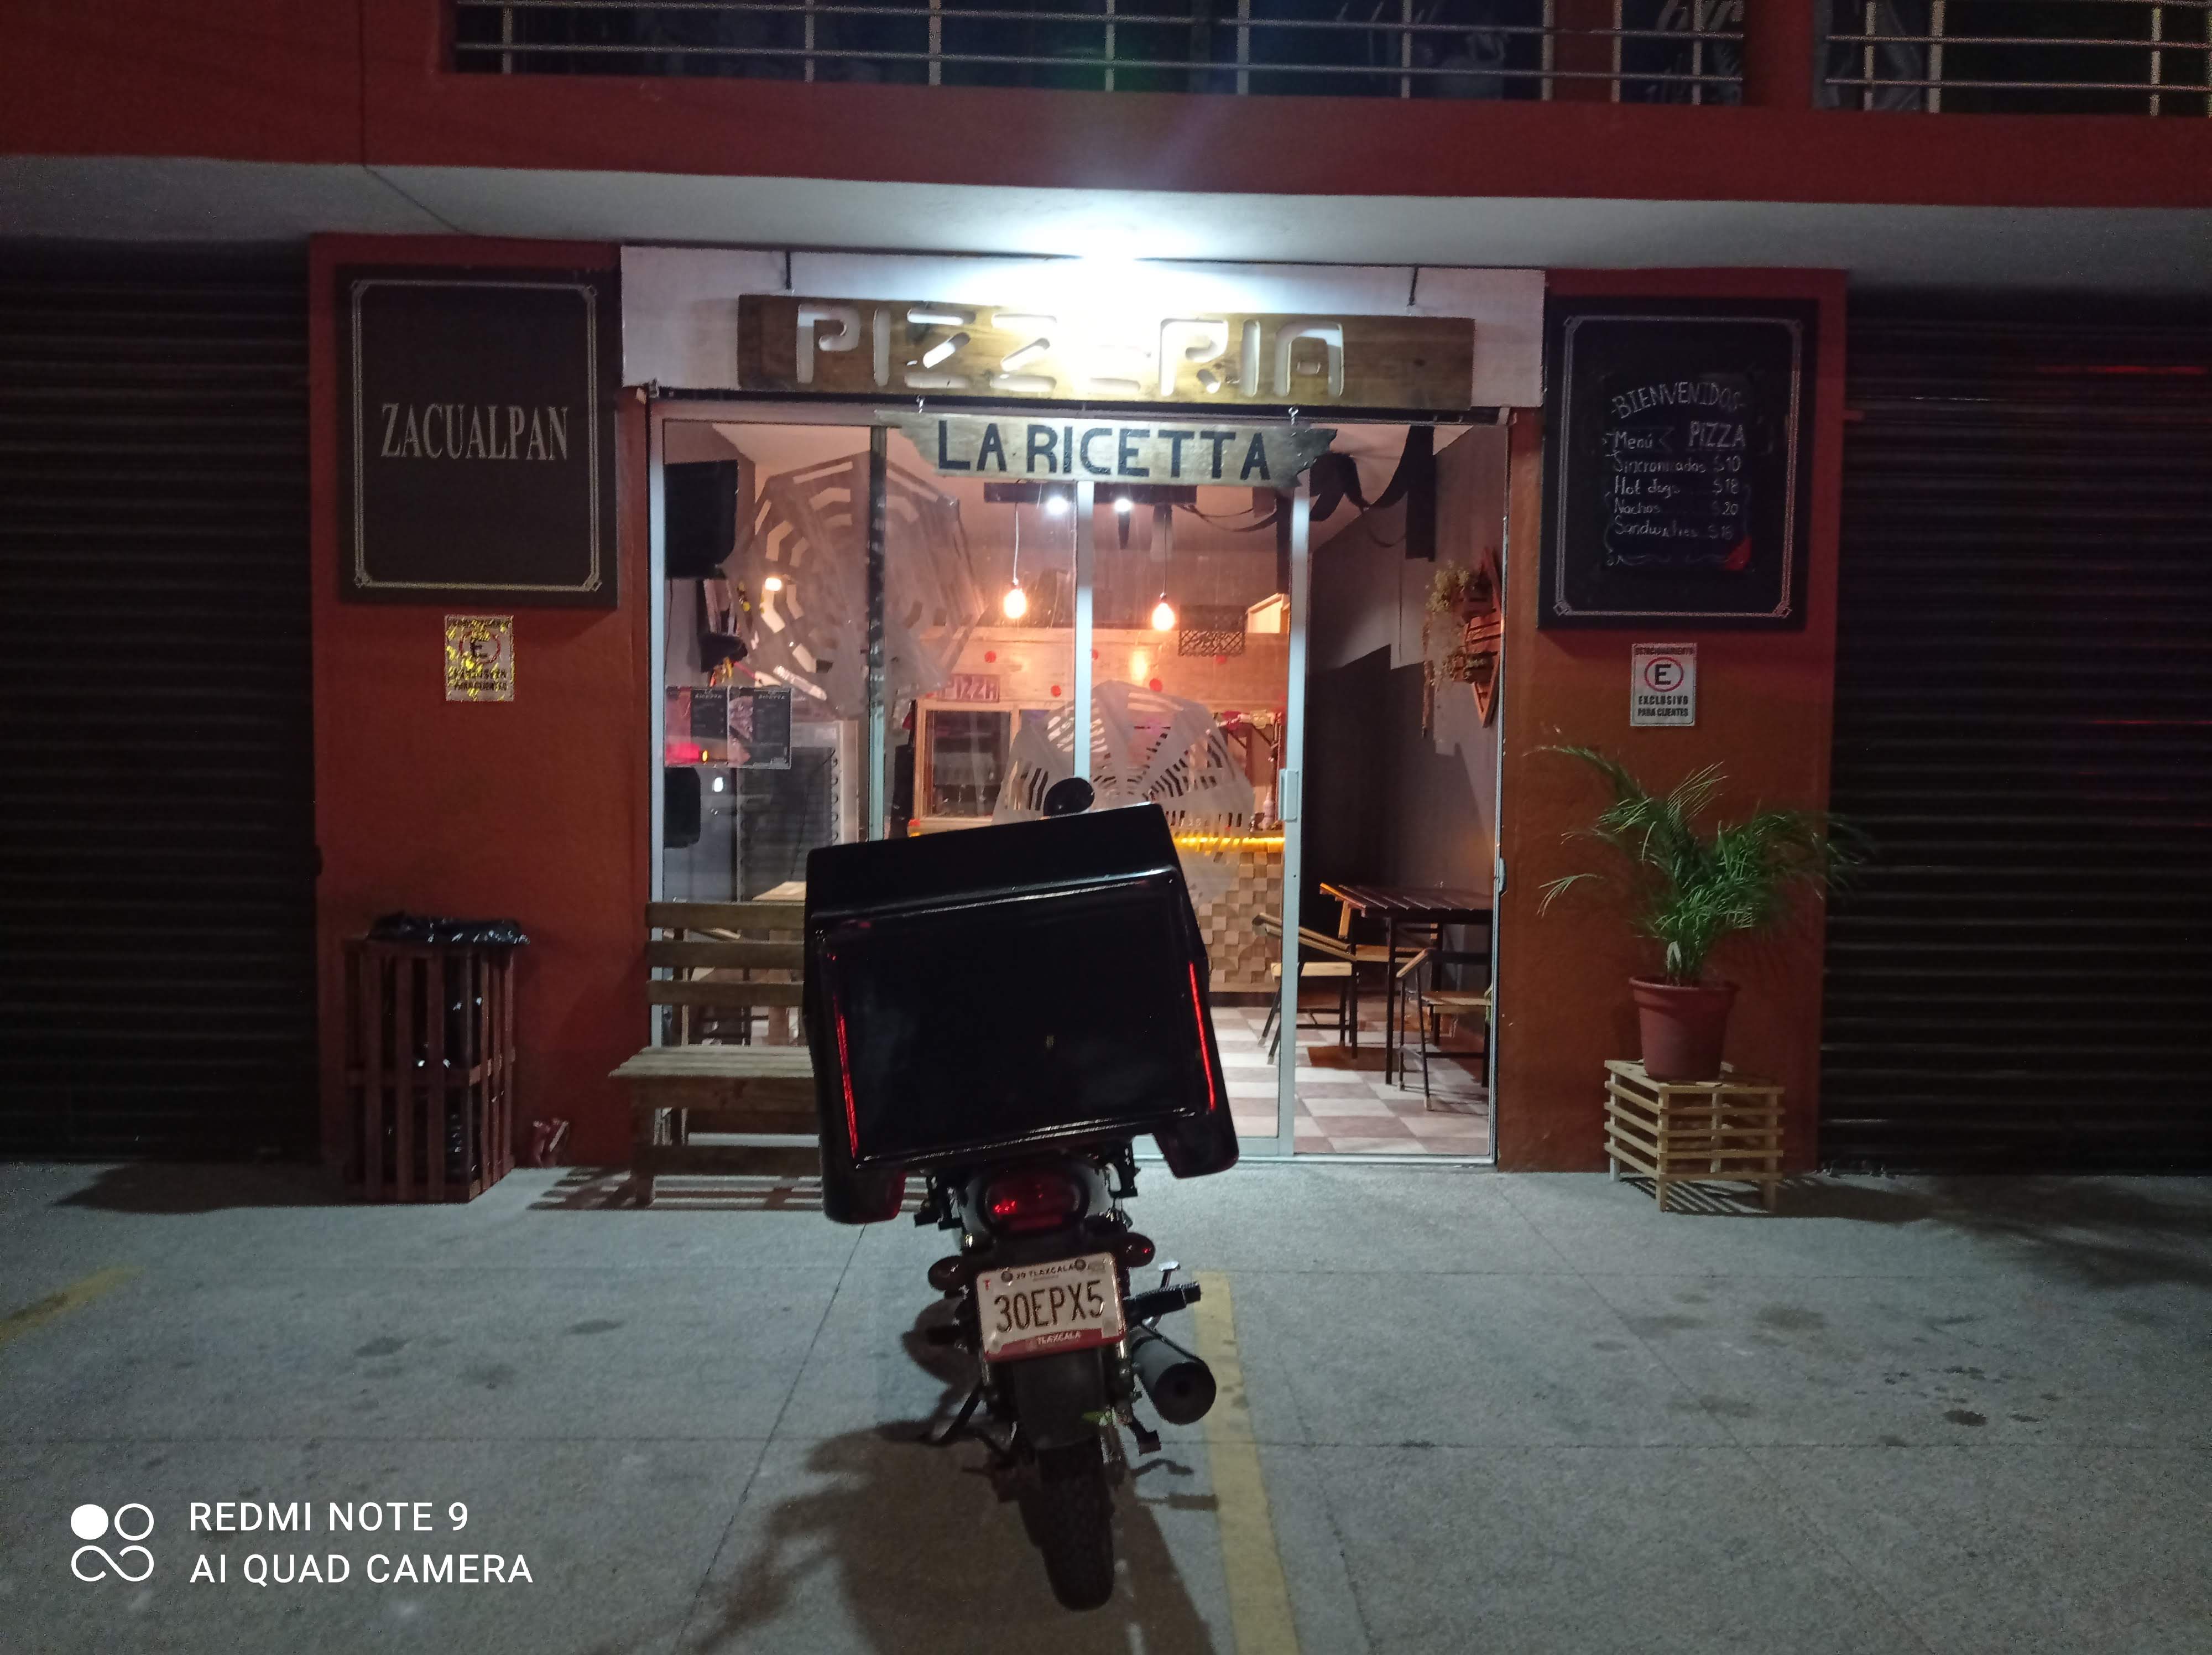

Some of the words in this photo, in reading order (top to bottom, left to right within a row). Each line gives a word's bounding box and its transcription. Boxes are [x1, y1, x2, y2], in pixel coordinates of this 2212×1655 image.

[380, 403, 568, 460] ZACUALPAN
[1688, 420, 1746, 447] PIZZA
[937, 419, 1006, 472] LA
[1025, 424, 1271, 482] RICETTA
[1614, 475, 1641, 495] Hot
[1654, 663, 1672, 685] E
[1638, 695, 1689, 705] EXCLUSIVO
[1637, 708, 1656, 717] PARA
[994, 1279, 1105, 1334] 30EPX5
